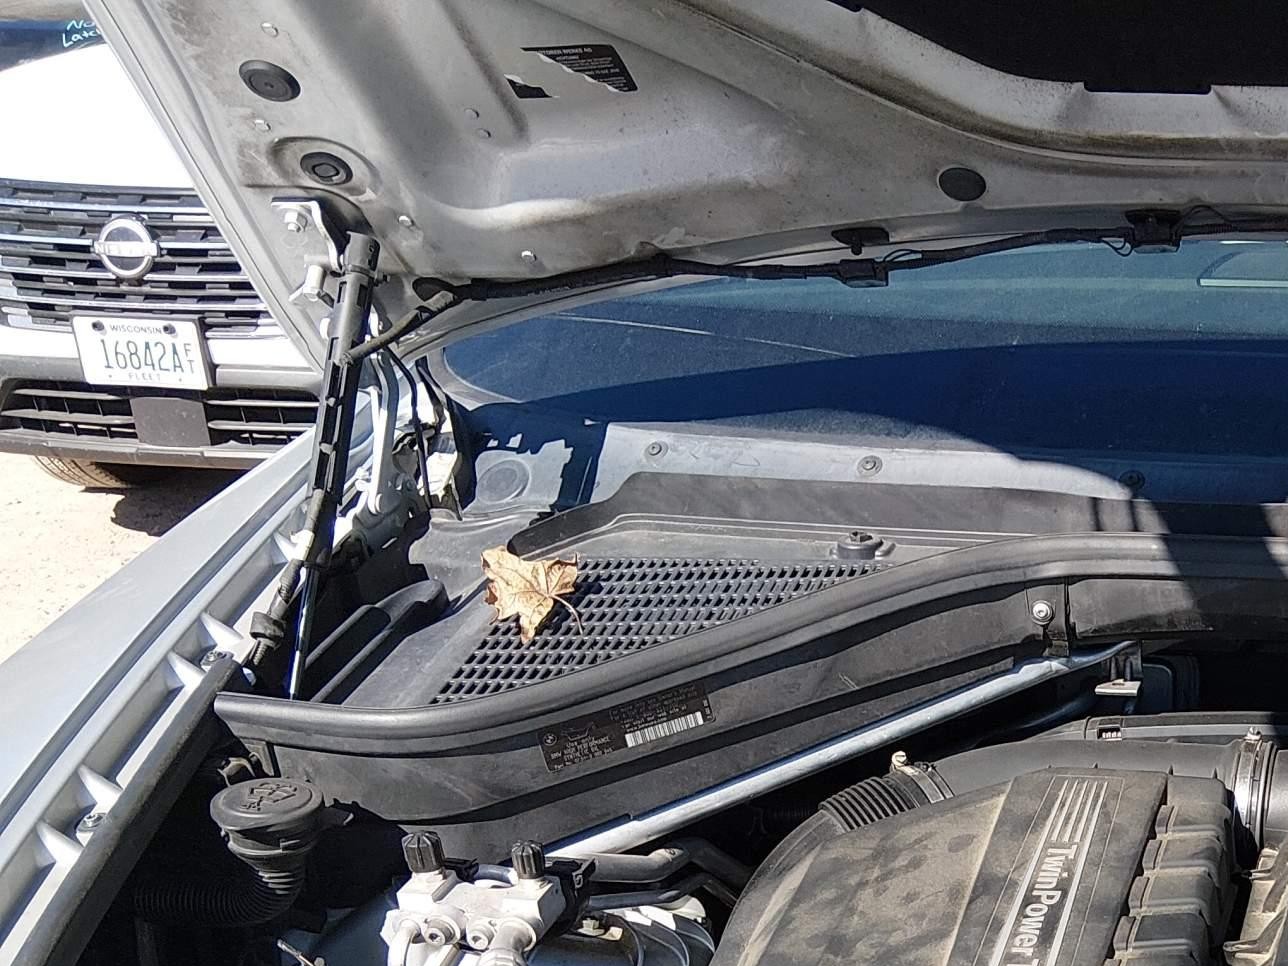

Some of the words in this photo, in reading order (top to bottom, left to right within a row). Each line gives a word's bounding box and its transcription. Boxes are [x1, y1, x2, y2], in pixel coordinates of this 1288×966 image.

[110, 324, 162, 334] WISCONSIN
[100, 339, 184, 373] 16842A
[128, 372, 161, 381] FLEET
[1011, 844, 1078, 956] TwinPower
